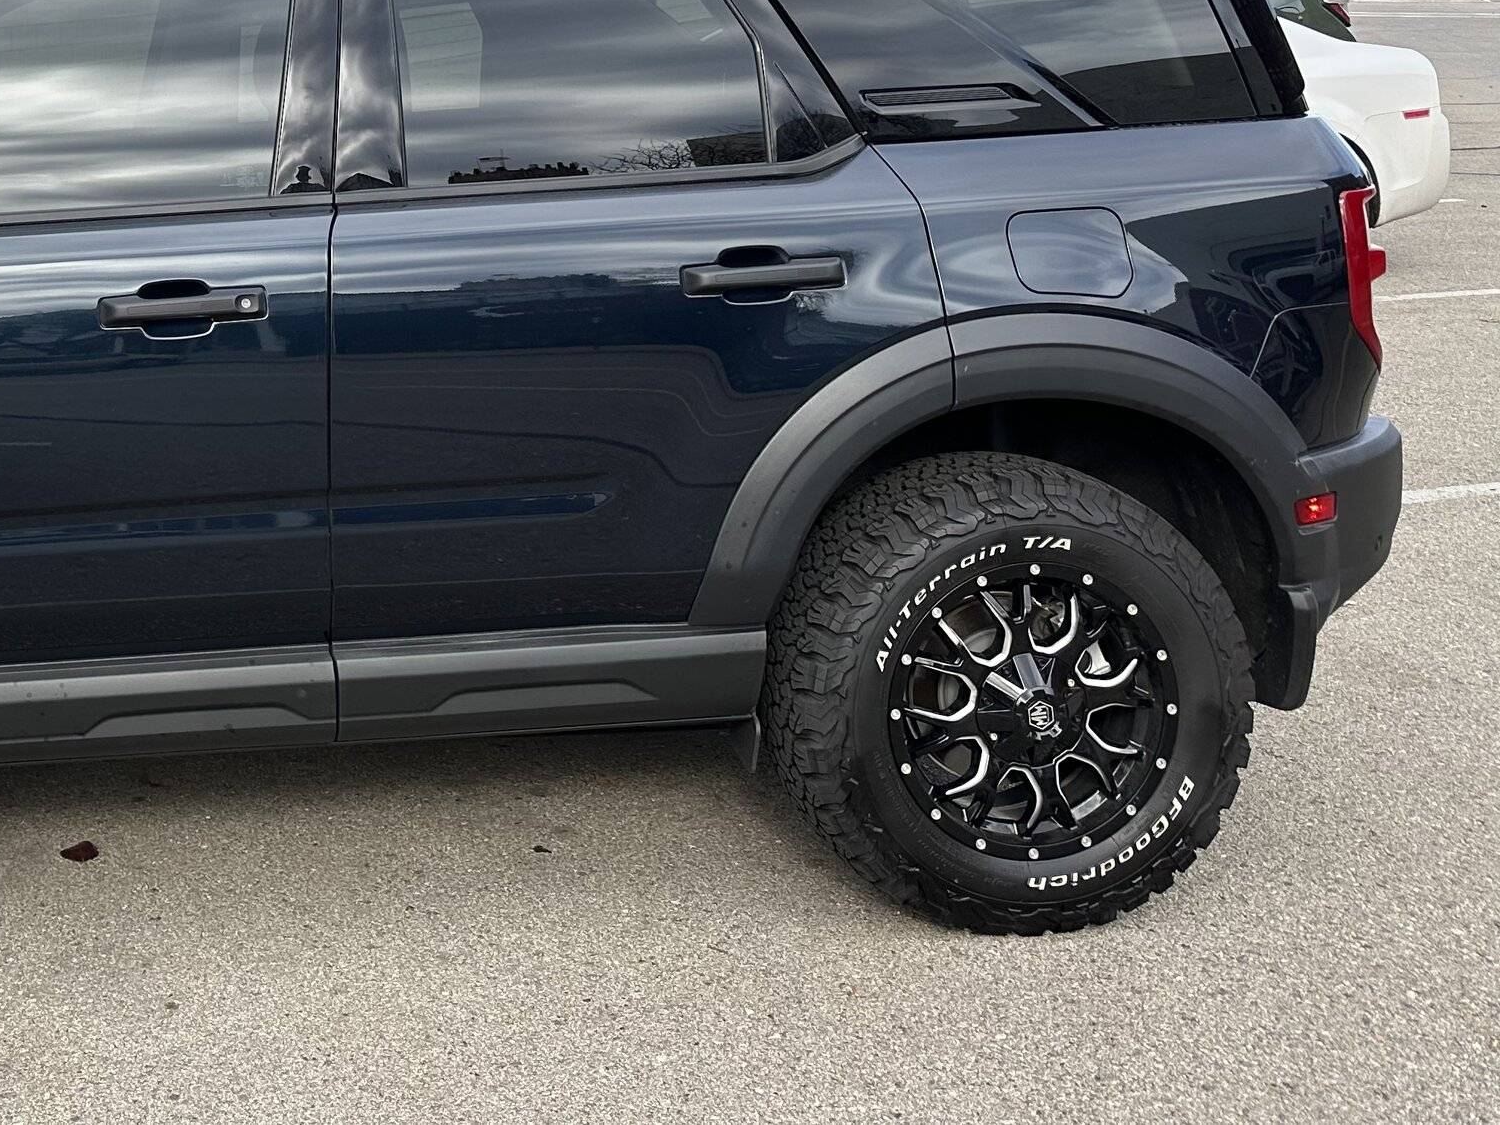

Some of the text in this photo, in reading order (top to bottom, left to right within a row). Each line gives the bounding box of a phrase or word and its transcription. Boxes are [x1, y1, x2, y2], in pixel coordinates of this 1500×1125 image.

[876, 536, 1072, 672] All-Terrain T/A
[1027, 775, 1195, 891] BFGoodrich
